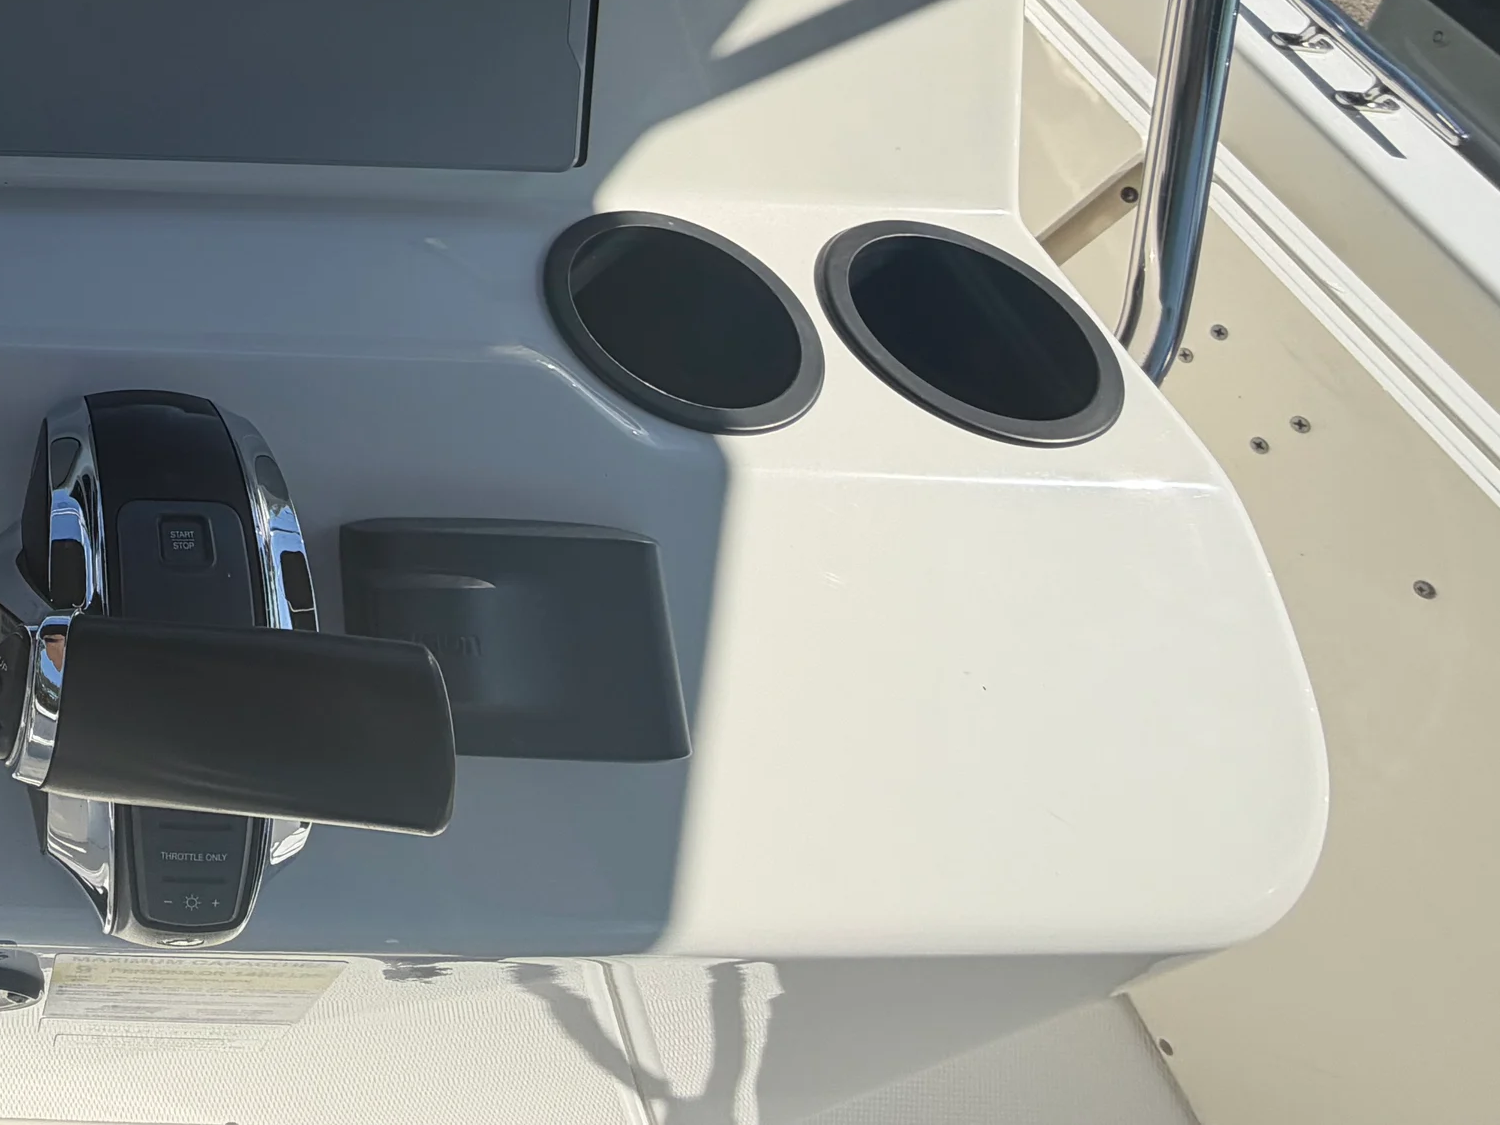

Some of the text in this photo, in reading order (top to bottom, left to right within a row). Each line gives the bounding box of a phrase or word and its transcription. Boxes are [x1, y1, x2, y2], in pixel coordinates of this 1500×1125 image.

[170, 530, 194, 539] START
[173, 541, 195, 550] STOP
[160, 851, 228, 862] THROTTLE ONLY
